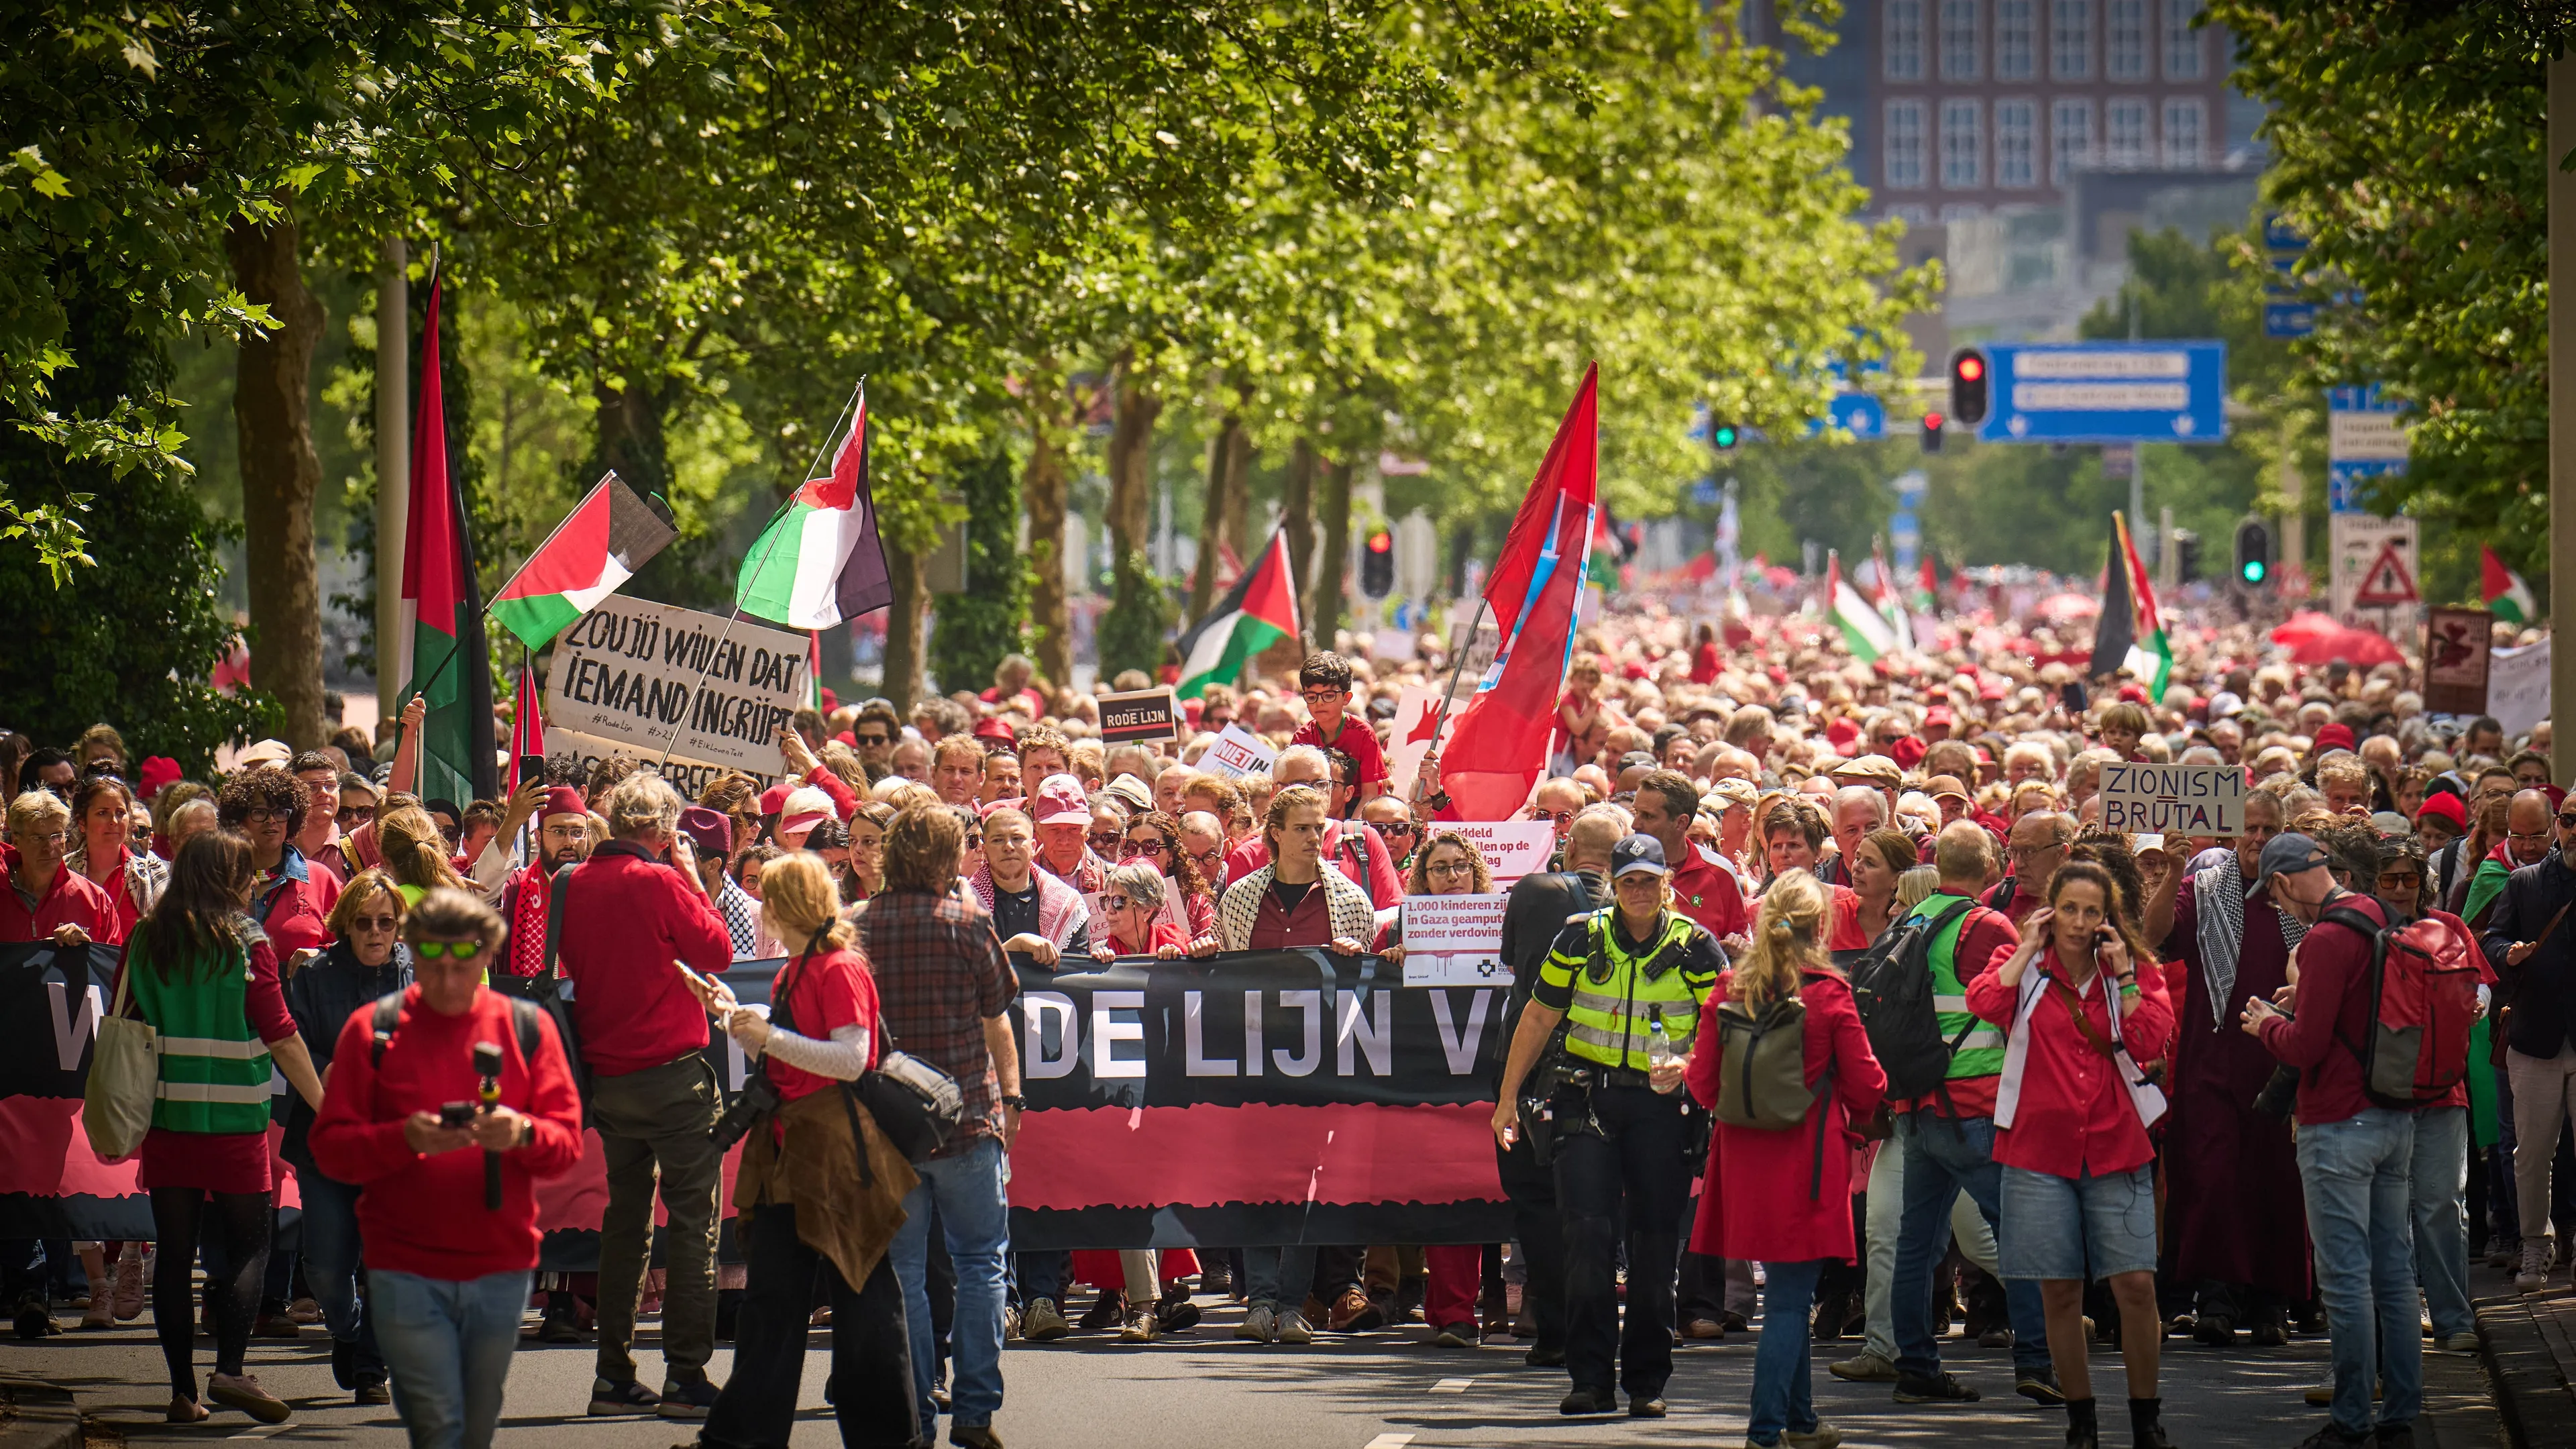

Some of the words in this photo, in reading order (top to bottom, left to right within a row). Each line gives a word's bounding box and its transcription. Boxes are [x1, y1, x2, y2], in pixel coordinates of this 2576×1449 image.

[566, 608, 629, 652] ZOU
[664, 623, 747, 683] WILLEN
[749, 647, 801, 694] DAT
[564, 650, 689, 724] IEMAND
[691, 680, 794, 747] INGRIJPT
[1107, 712, 1138, 727] RODE
[1140, 710, 1166, 724] LIJN
[1214, 739, 1254, 769] NIET
[1248, 757, 1270, 773] IN
[2106, 767, 2239, 797] ZIONISM
[2106, 800, 2233, 833] BRUTAL
[1499, 842, 1514, 853] op
[1516, 840, 1529, 851] de
[1407, 901, 1439, 912] 1.000
[1440, 900, 1491, 911] kinderen
[1407, 914, 1418, 925] in
[1420, 914, 1450, 924] Gaza
[1407, 928, 1447, 939] zonder
[1184, 989, 1391, 1077] LIJN
